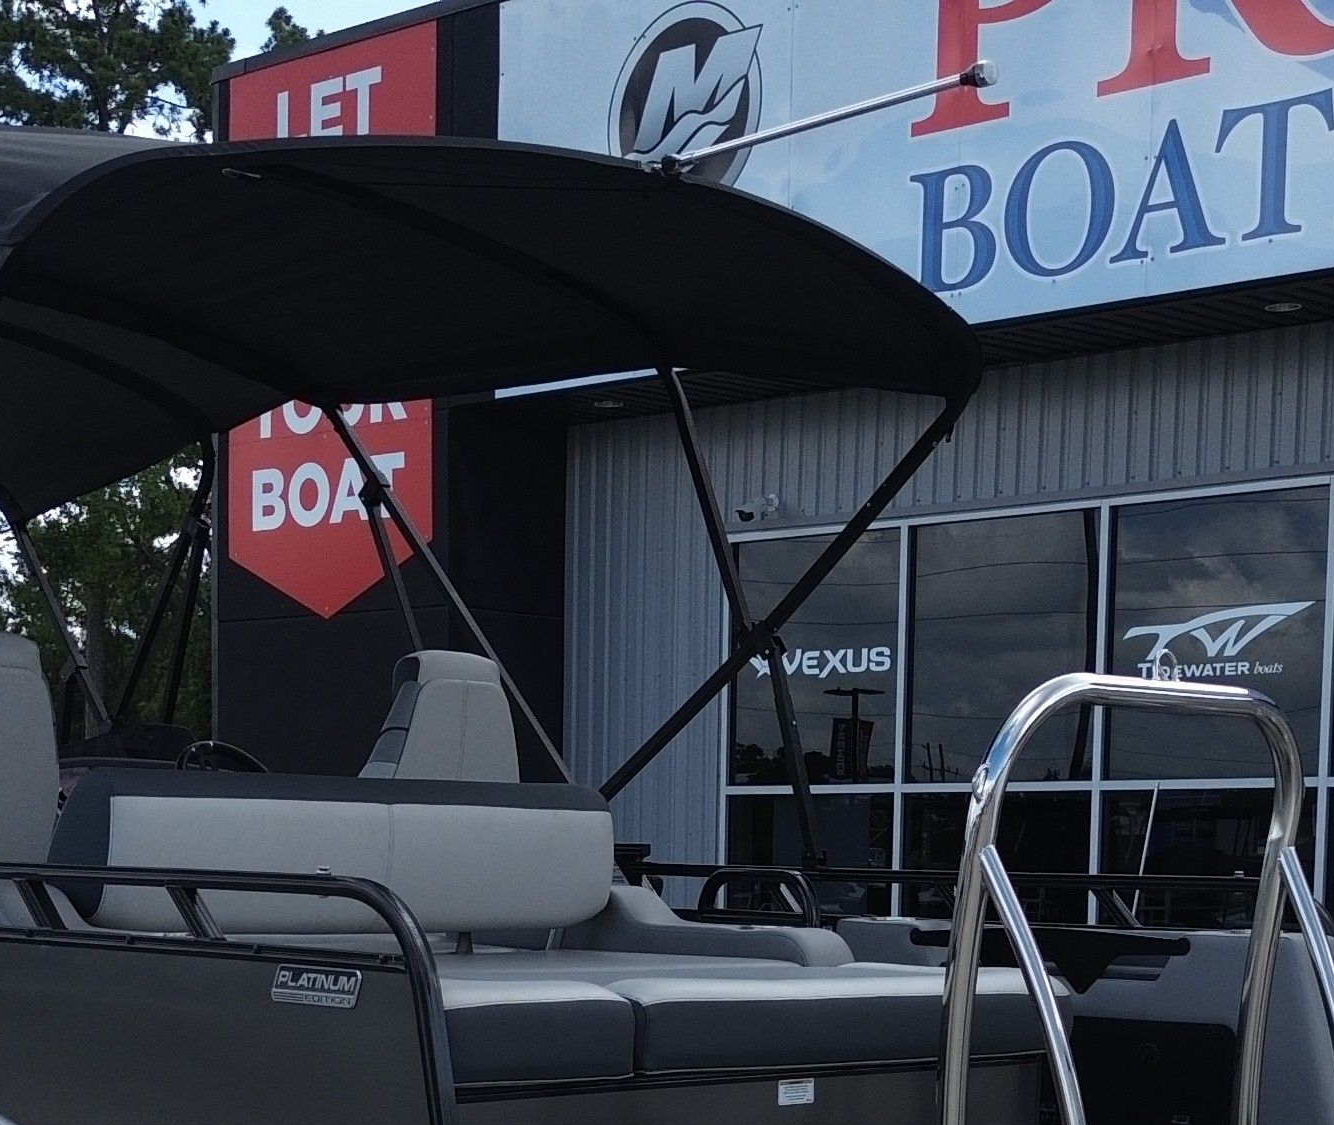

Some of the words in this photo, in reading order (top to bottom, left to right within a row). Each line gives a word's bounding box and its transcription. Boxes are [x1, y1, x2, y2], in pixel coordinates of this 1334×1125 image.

[277, 66, 382, 139] LET
[252, 451, 405, 532] BOAT
[782, 647, 891, 679] VEXUS
[1253, 661, 1284, 675] boats
[277, 970, 357, 992] PLATINUM
[304, 994, 351, 1006] EDITION
